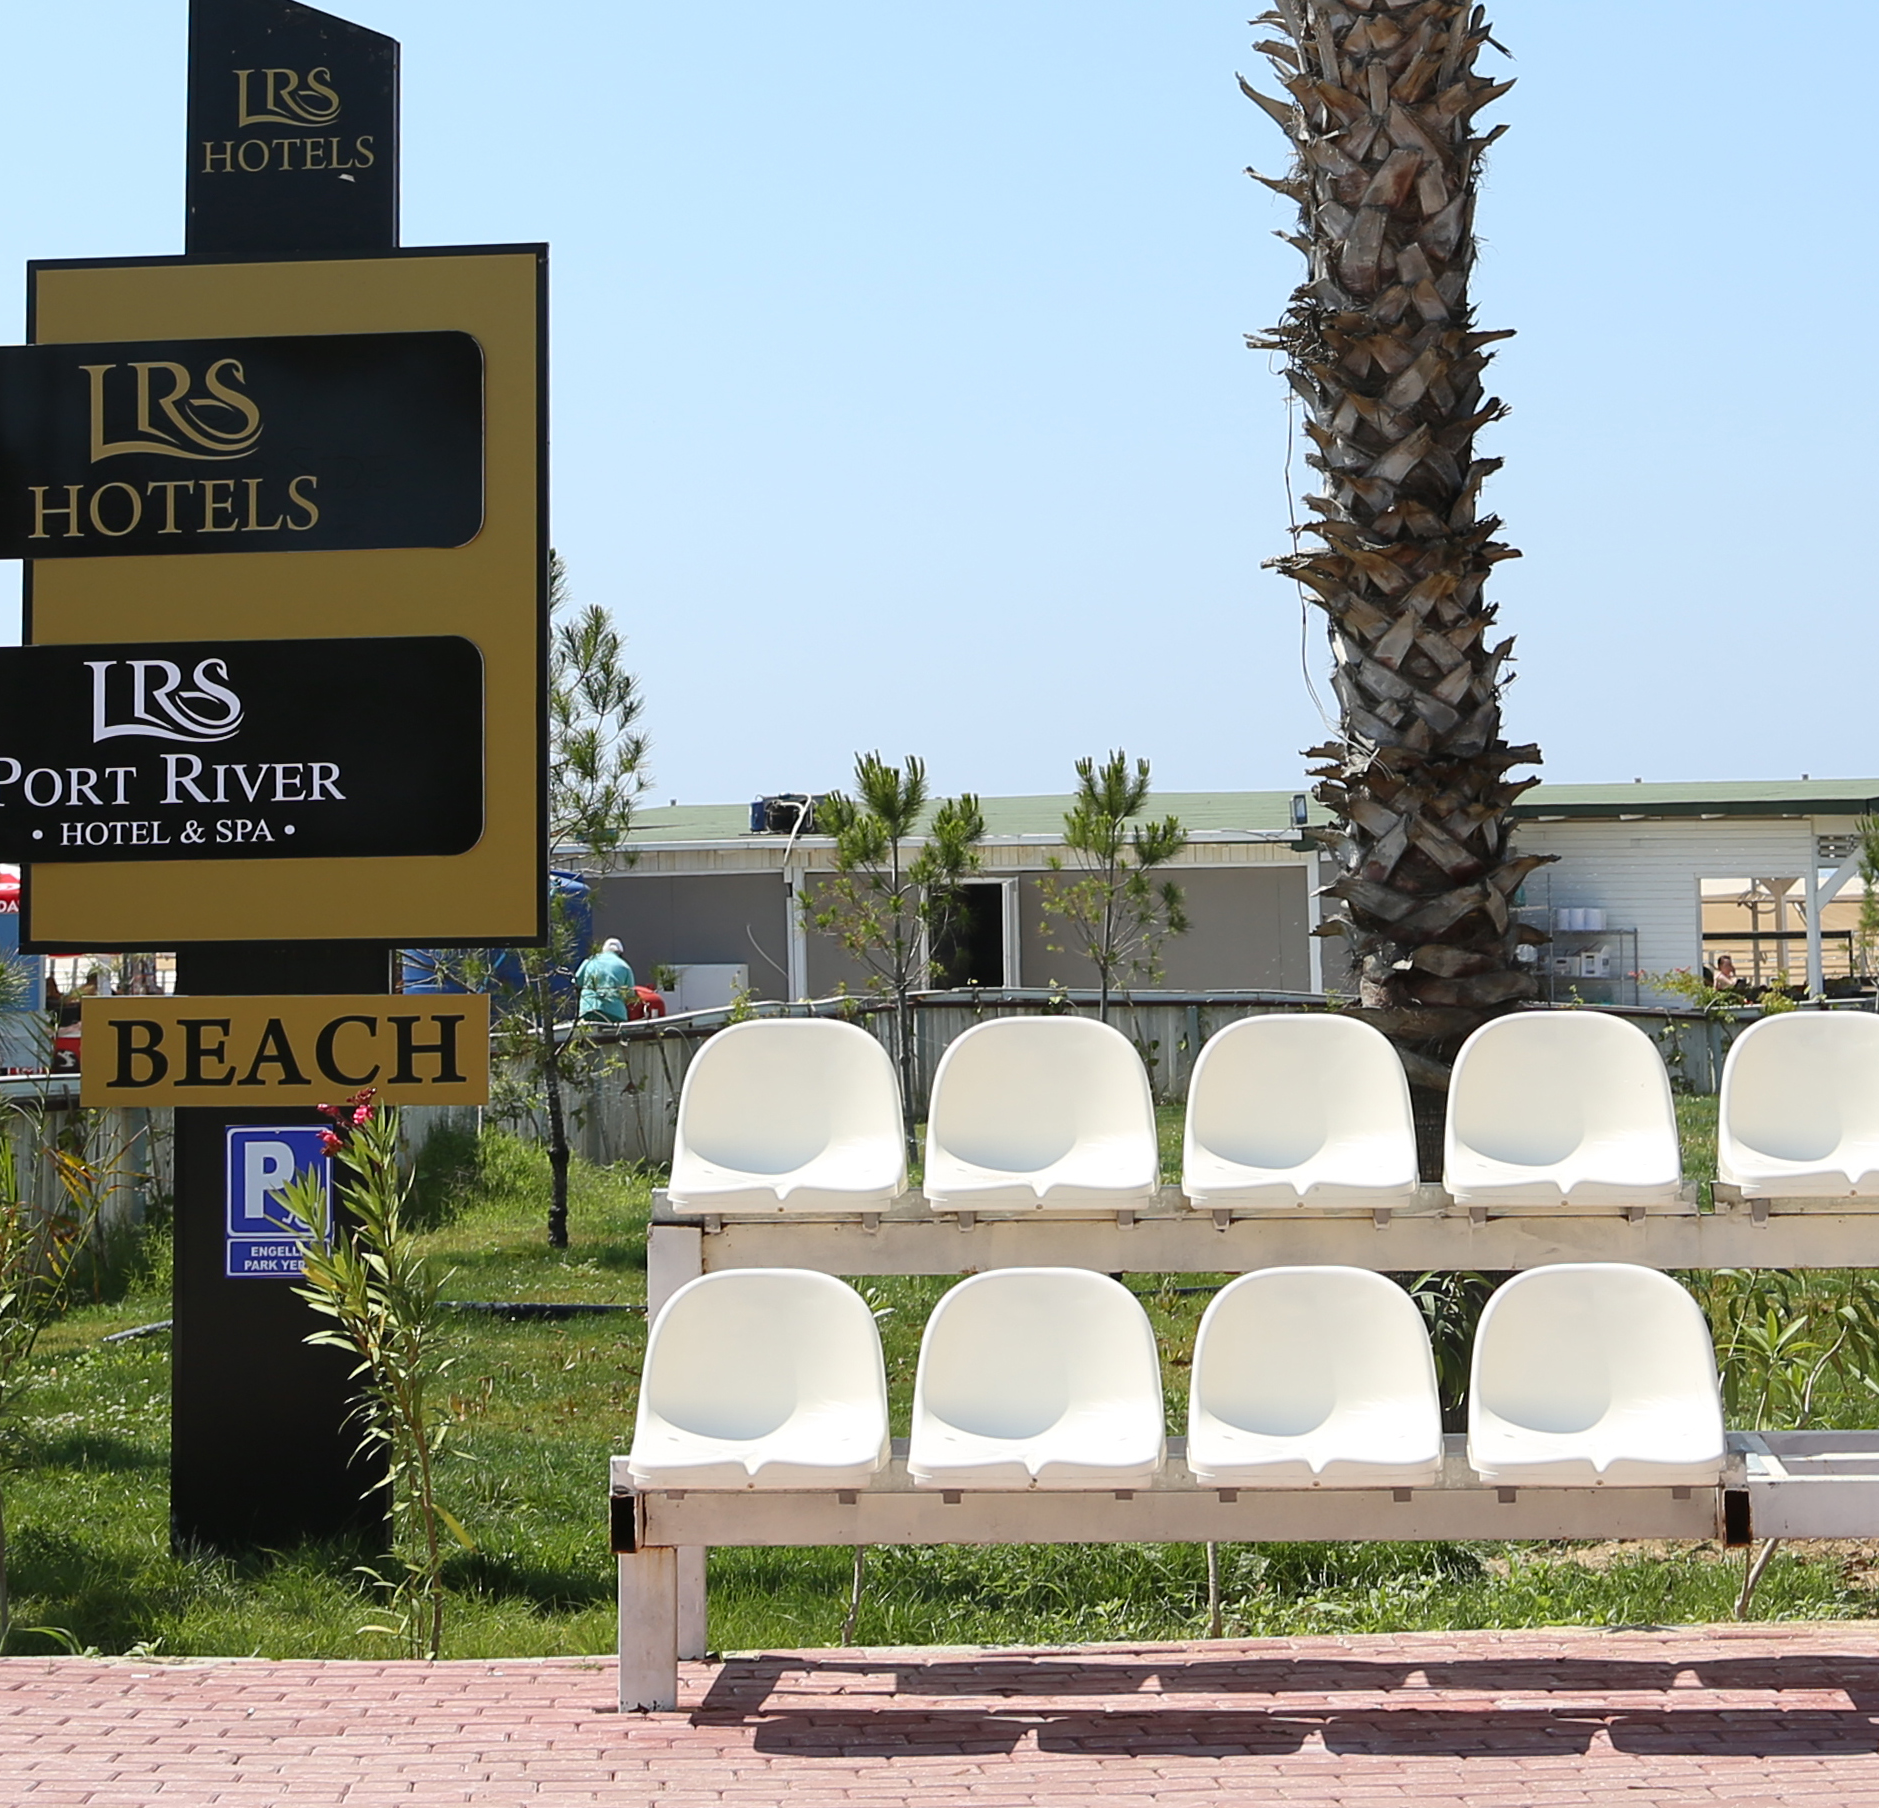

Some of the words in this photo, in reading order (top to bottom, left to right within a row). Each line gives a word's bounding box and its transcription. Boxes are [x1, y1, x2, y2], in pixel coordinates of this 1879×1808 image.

[232, 67, 342, 128] LRS
[201, 135, 375, 173] HOTELS
[78, 358, 265, 464] LRS
[27, 475, 320, 539] HOTELS
[83, 658, 245, 743] LRS
[60, 821, 171, 846] HOTEL
[180, 819, 205, 844] &
[216, 818, 276, 843] SPA
[106, 1014, 468, 1089] BEACH
[244, 1141, 295, 1219] P
[244, 1259, 278, 1271] PARK
[280, 1259, 308, 1271] YER
